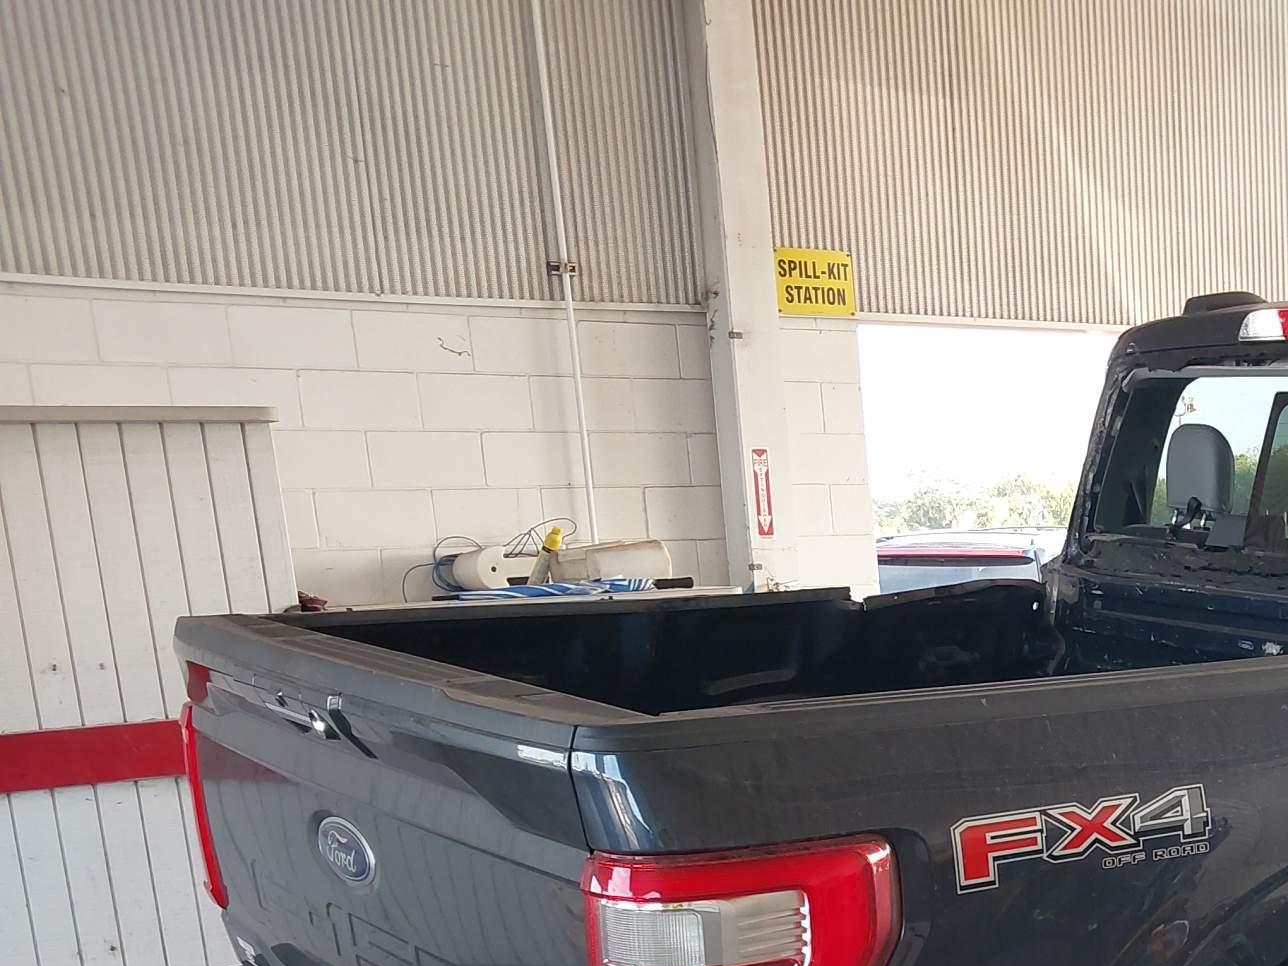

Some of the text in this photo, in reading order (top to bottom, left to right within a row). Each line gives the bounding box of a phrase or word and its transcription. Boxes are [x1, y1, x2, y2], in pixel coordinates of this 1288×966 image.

[778, 259, 848, 281] SPILL-KIT
[785, 285, 847, 306] STATION
[951, 784, 1210, 894] FX4
[1102, 842, 1210, 869] OFF ROAD
